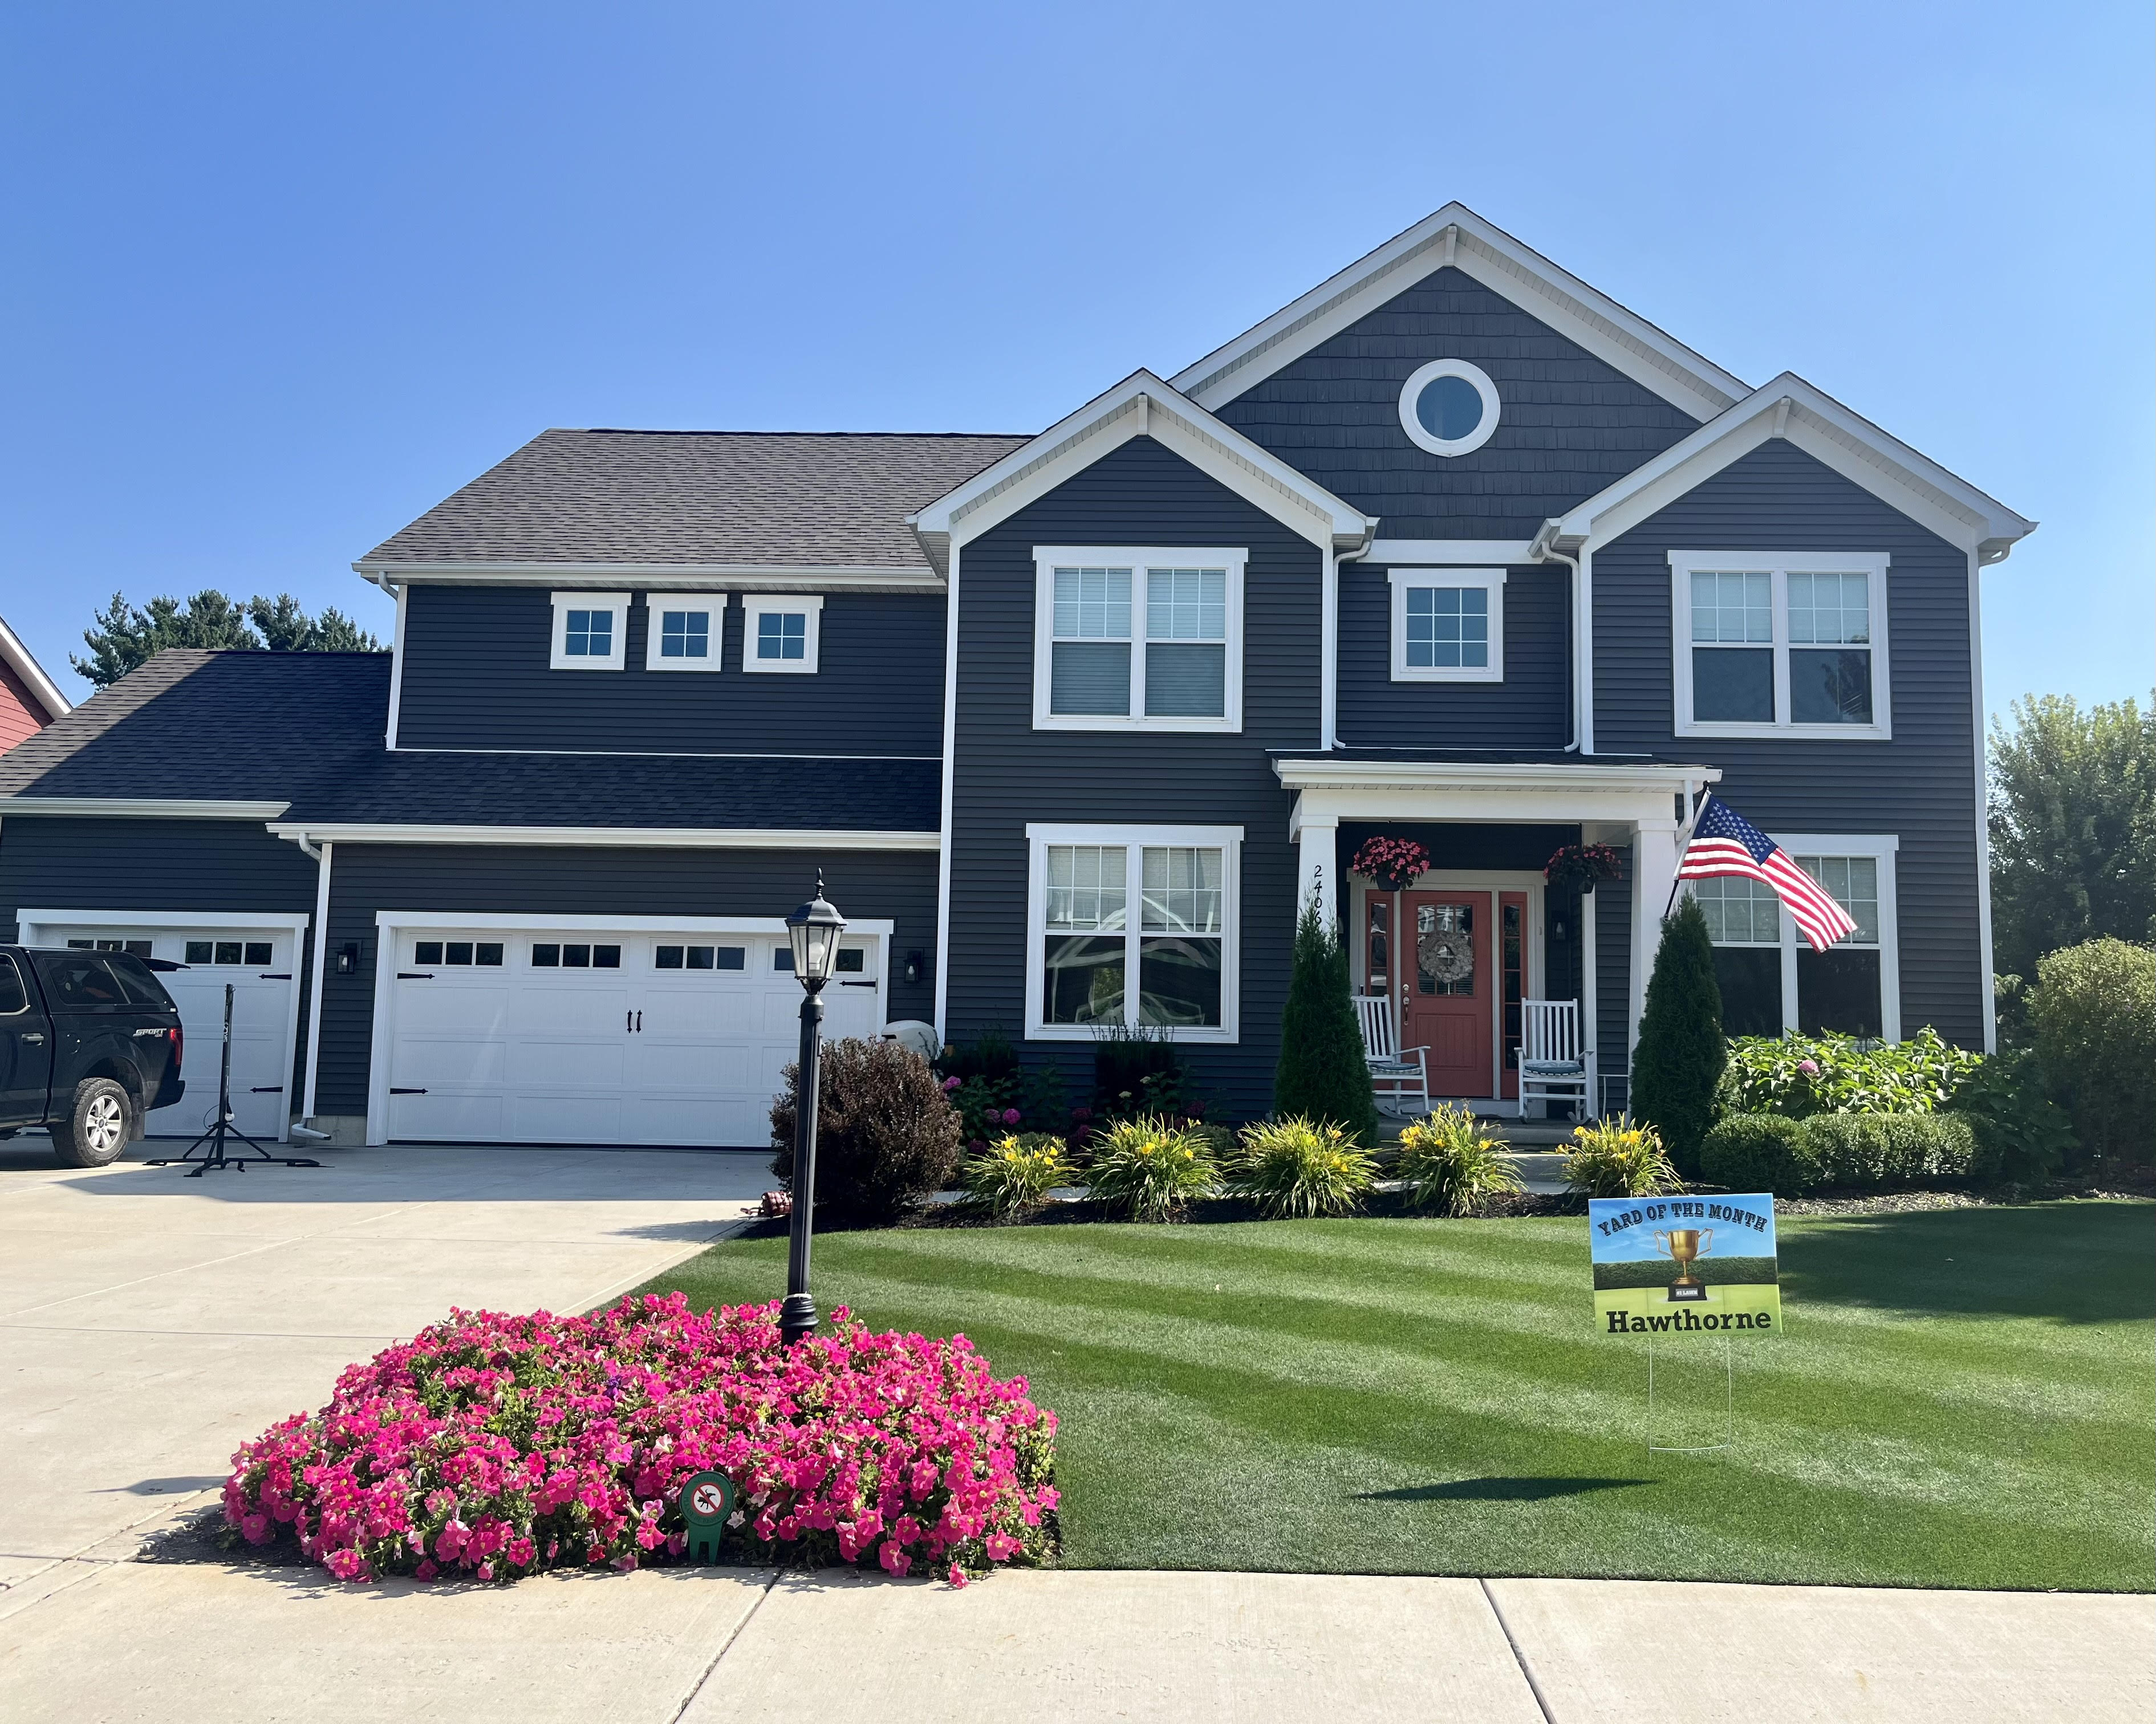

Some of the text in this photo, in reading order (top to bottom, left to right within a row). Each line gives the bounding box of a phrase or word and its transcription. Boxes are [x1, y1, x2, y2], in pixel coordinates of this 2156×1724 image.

[1314, 865, 1322, 924] 2406
[133, 1028, 167, 1037] SPORT
[1597, 1202, 1768, 1236] YARD OF THE MONTH
[1606, 1309, 1771, 1333] Hawthorne
